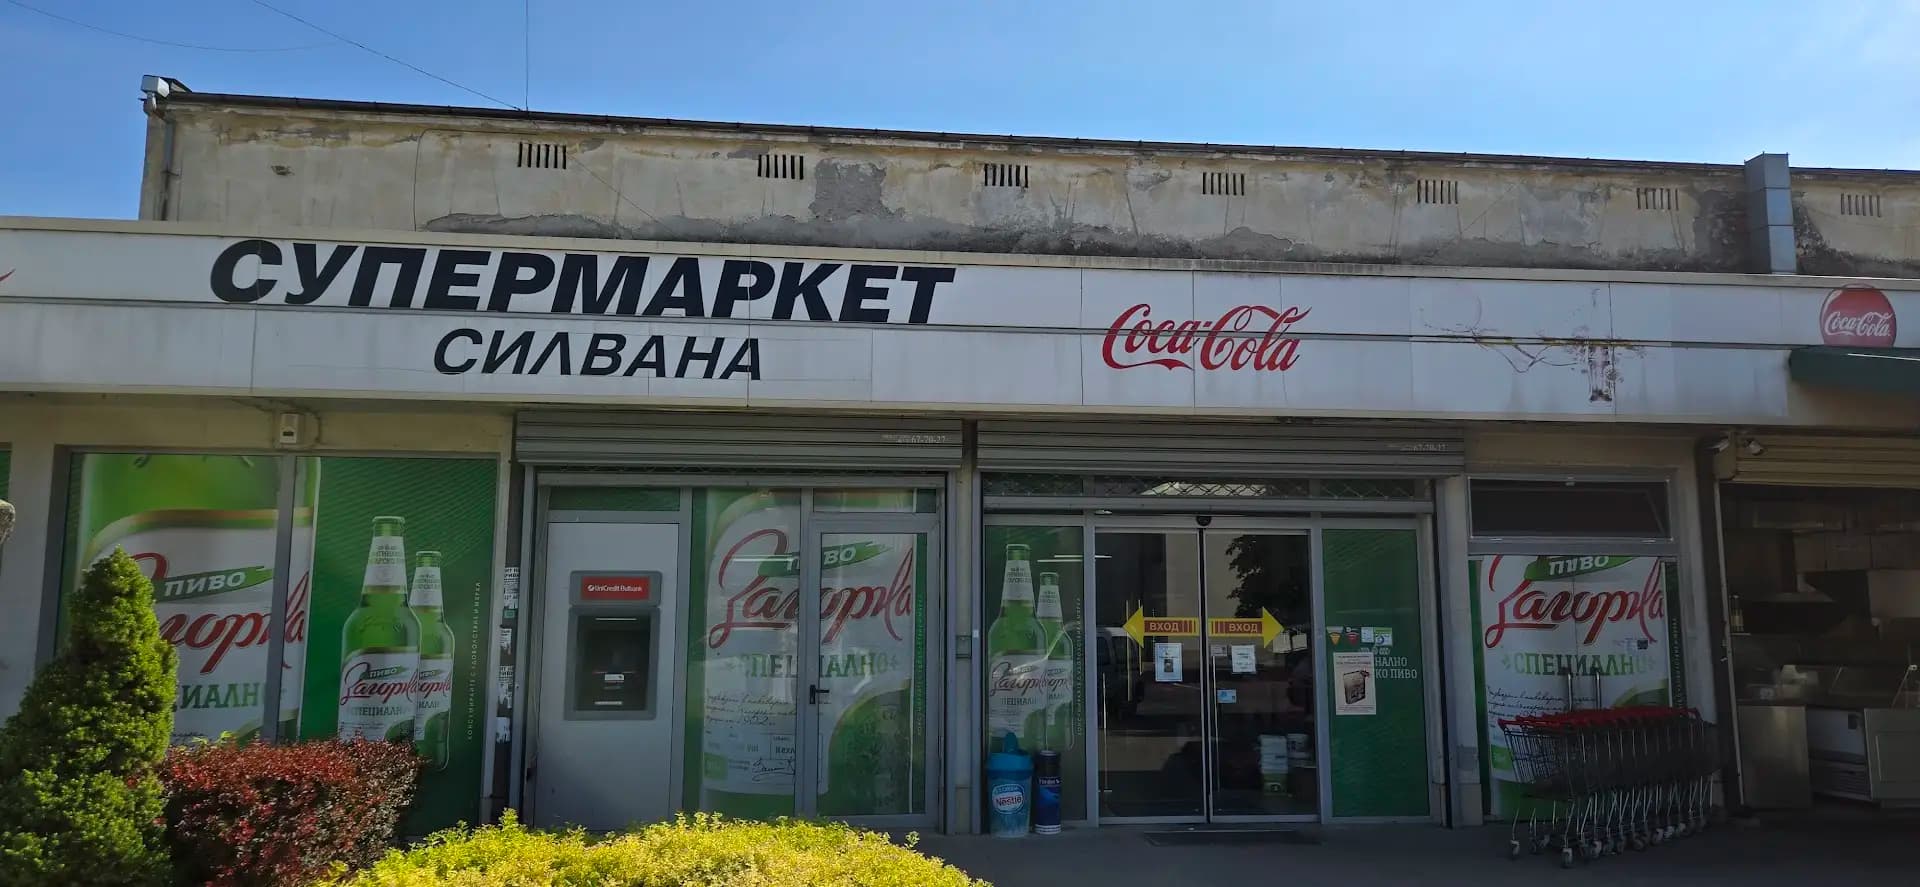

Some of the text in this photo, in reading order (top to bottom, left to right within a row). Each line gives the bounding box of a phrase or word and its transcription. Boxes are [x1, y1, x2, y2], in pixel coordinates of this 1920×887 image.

[209, 238, 955, 325] СУПЕРМАРКЕТ
[1824, 310, 1893, 337] Coca-Cola
[1102, 302, 1312, 373] Coca-Cola
[432, 327, 762, 382] СИЛВАНА
[786, 545, 857, 573] ПВО
[164, 571, 246, 598] ПИВО
[1485, 555, 1666, 649] Загорка
[1150, 622, 1179, 632] ВХОД
[1229, 624, 1258, 633] ВХОД
[1390, 668, 1418, 680] ПИВО
